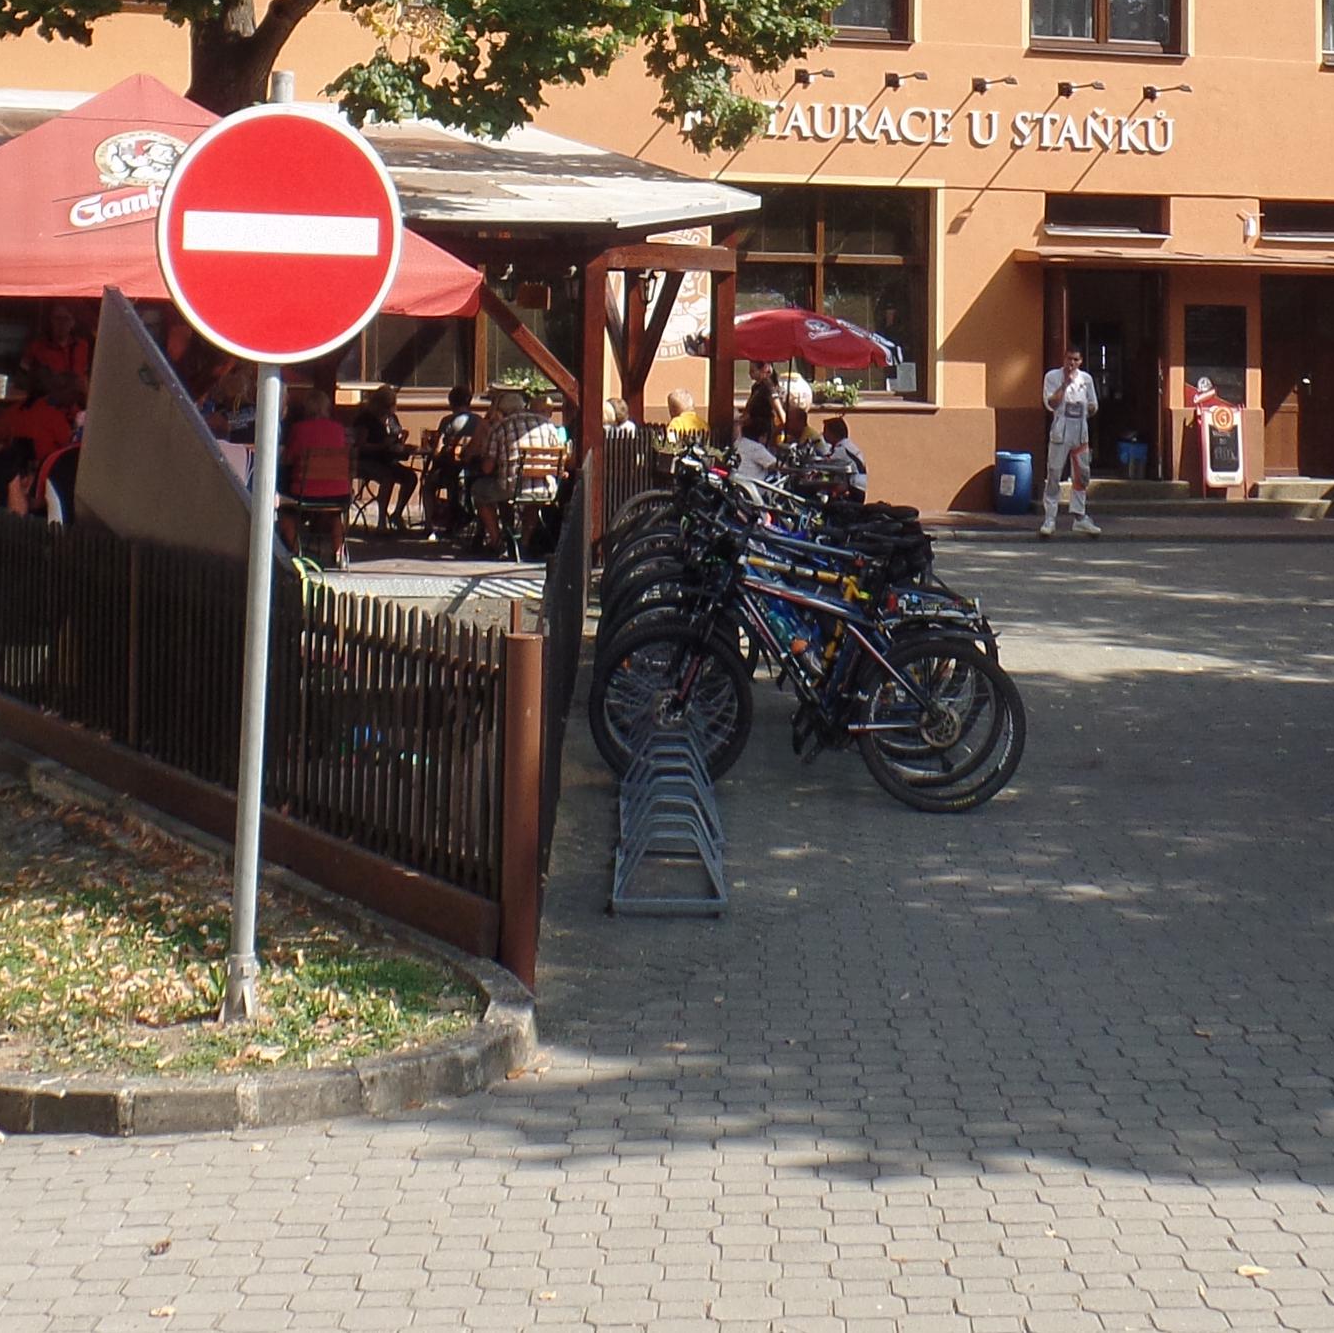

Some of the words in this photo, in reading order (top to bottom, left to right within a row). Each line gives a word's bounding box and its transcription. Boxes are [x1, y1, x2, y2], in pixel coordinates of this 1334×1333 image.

[682, 101, 954, 145] TAURACE
[968, 109, 1000, 147] U
[1012, 107, 1175, 154] STAŇKŮ
[69, 184, 163, 227] Gamb
